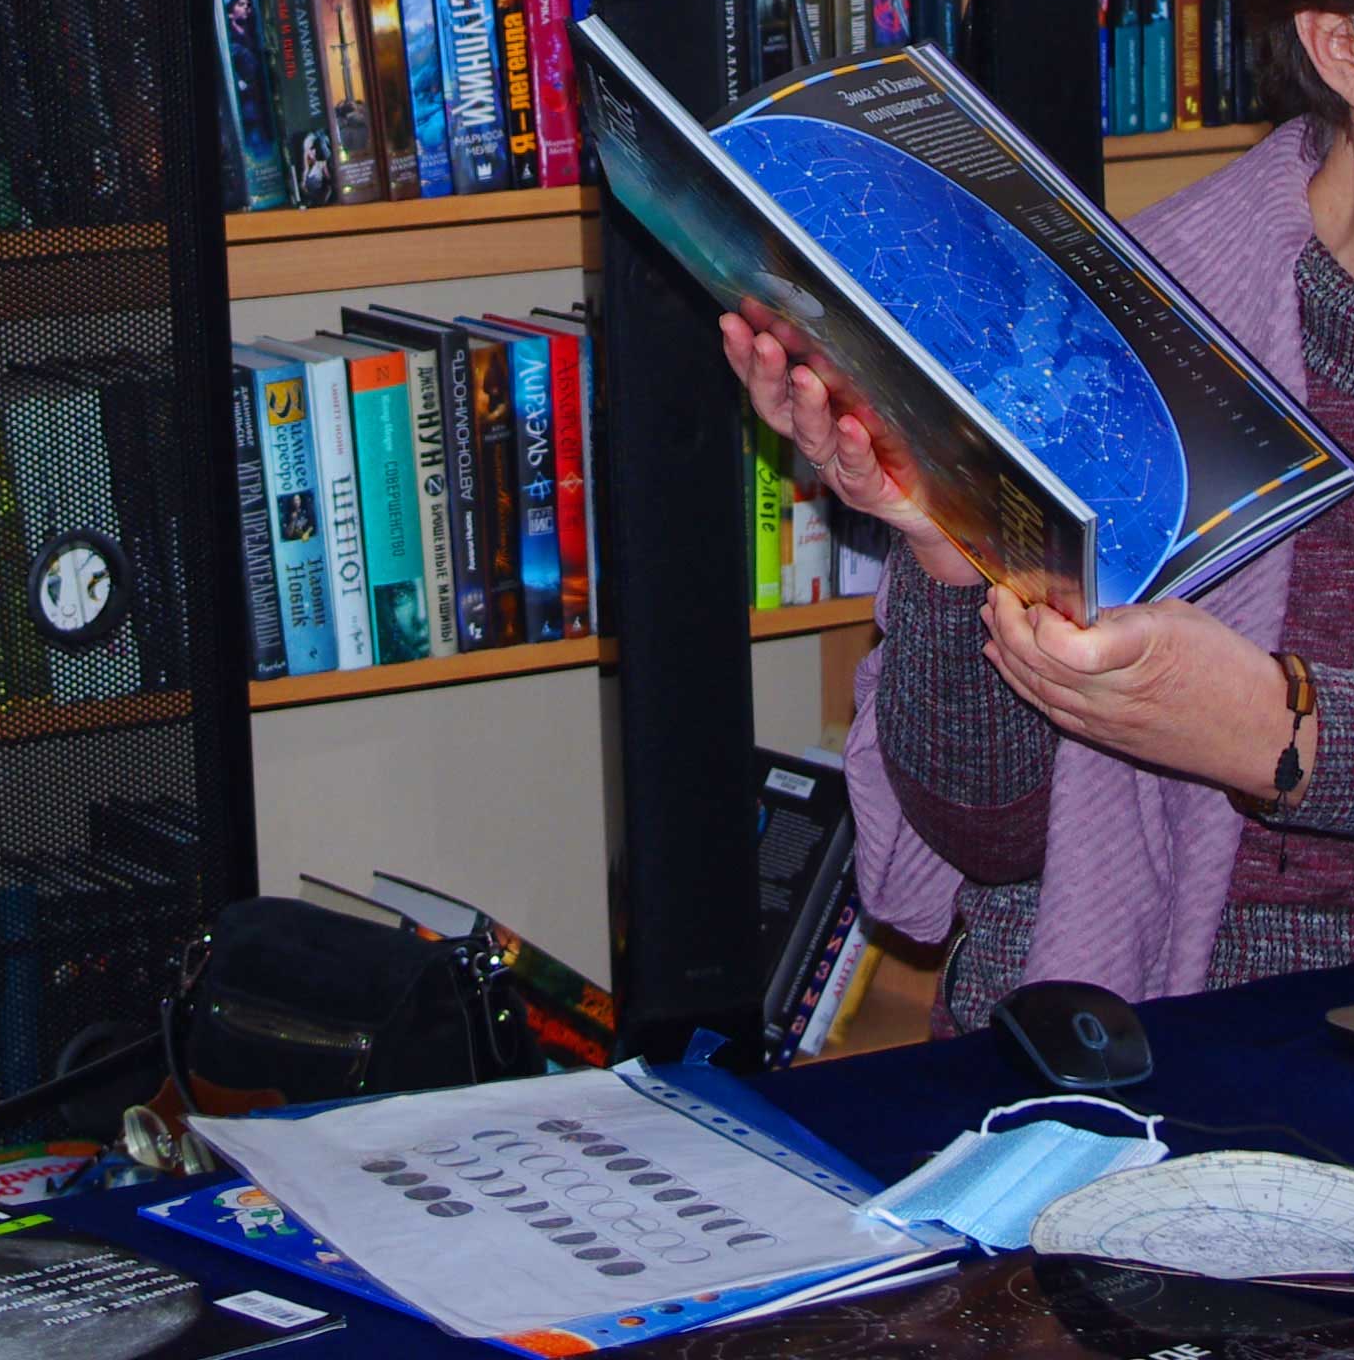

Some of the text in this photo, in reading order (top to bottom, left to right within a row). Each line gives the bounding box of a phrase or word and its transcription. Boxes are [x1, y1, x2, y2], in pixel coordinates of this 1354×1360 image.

[502, 12, 536, 154] Я легенда
[415, 366, 443, 468] ДЖЕФФ НУН
[450, 349, 475, 499] АВТОНОМНОСТЬ
[272, 423, 295, 491] серебро
[382, 460, 407, 557] СОВЕРШЕНСТВО
[237, 459, 279, 649] ИГРА ПРЕДАТЕЛЬНИЦЫ
[428, 503, 453, 643] БРОШЕННЫЕ МАШИНЫ
[284, 561, 311, 628] Новик
[34, 1258, 138, 1290] отражения
[42, 1252, 118, 1277] спутник
[42, 1295, 92, 1311] Фазы
[115, 1272, 179, 1295] циклы
[75, 1265, 158, 1292] кратеров
[42, 1310, 91, 1327] Луна
[109, 1281, 199, 1309] затмения
